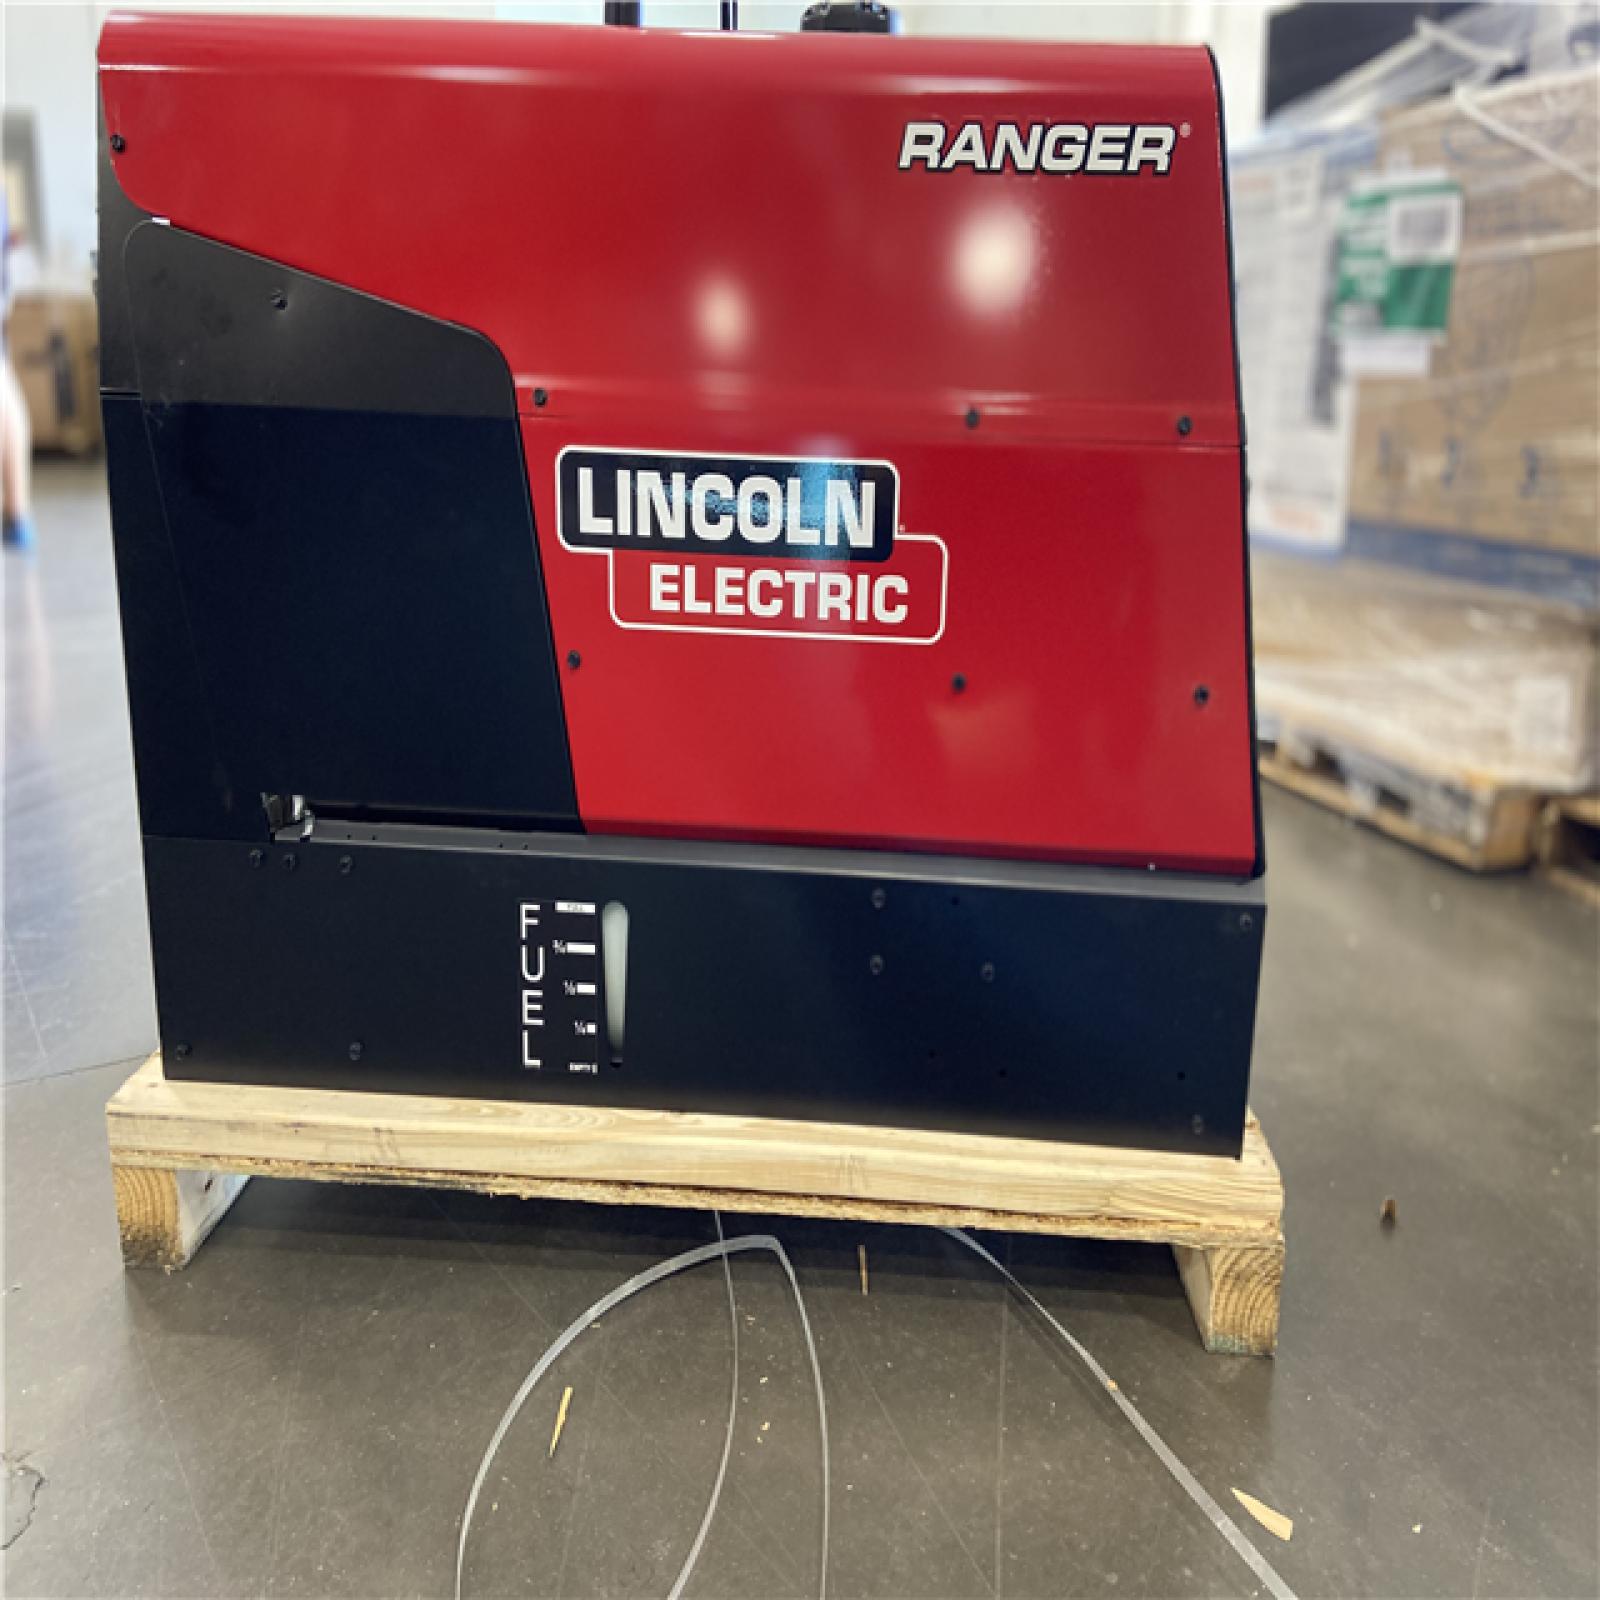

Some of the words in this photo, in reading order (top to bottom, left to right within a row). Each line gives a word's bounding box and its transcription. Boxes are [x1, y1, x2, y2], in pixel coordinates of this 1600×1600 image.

[897, 121, 1178, 174] RANGER
[576, 466, 876, 548] LINCOLN
[649, 562, 909, 624] ELECTRIC
[519, 902, 546, 1069] FUEL
